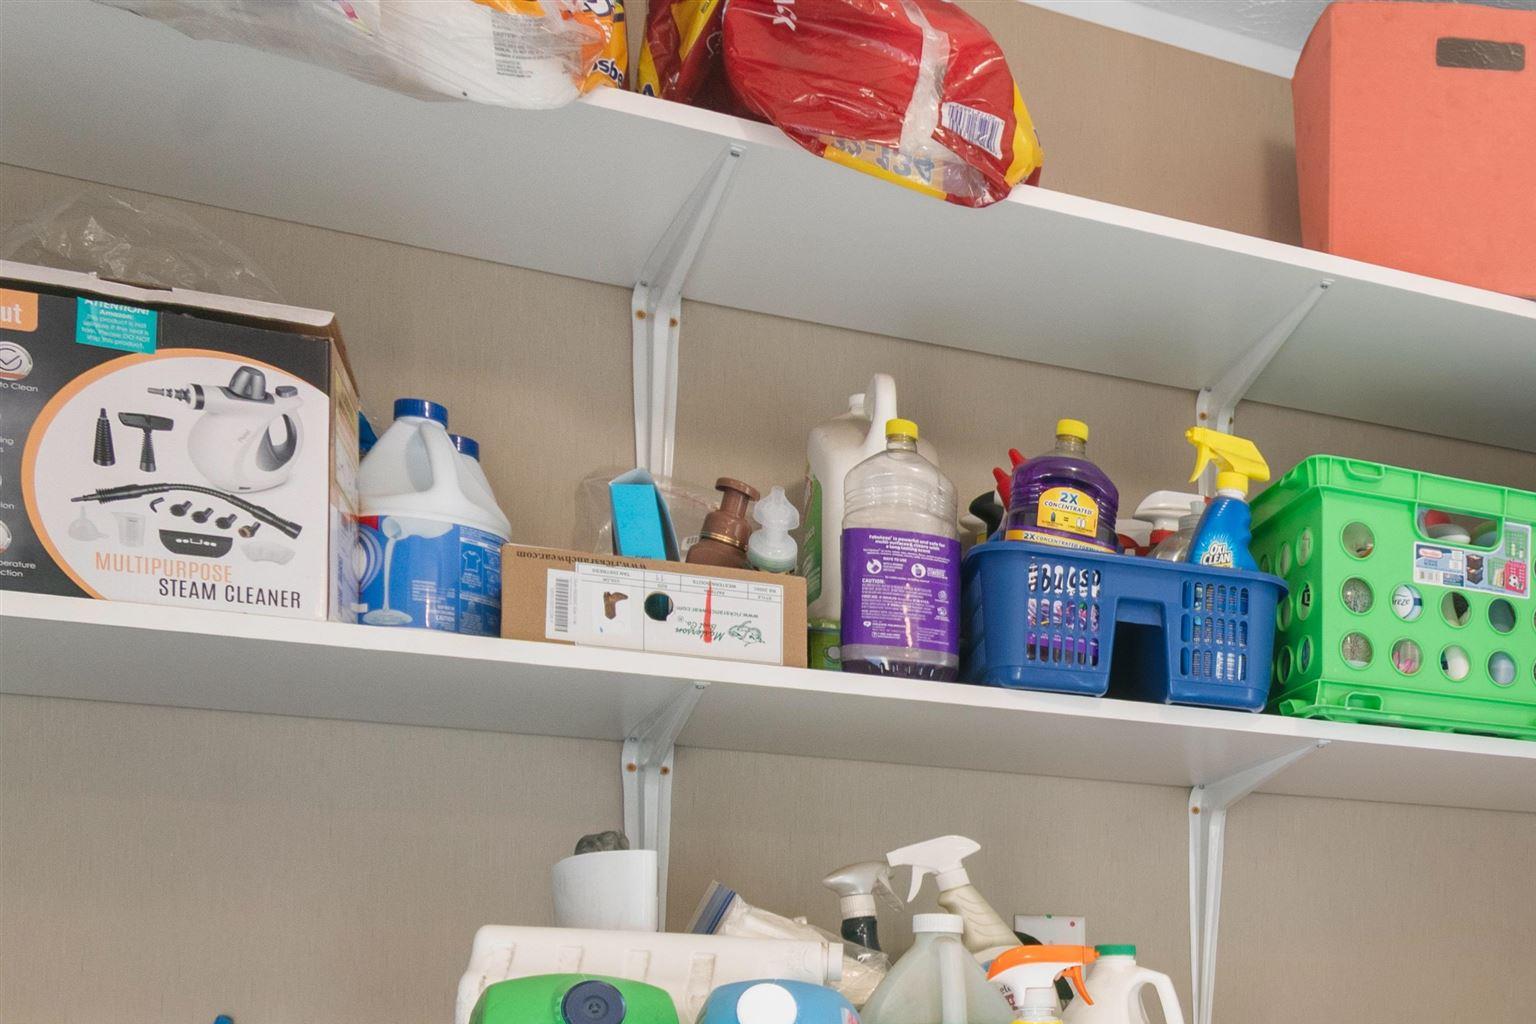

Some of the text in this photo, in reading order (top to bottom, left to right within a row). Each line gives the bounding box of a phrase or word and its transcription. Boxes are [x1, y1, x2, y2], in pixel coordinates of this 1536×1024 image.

[11, 382, 39, 393] Clean
[1060, 492, 1078, 505] 2X
[1024, 532, 1035, 540] 2X
[1210, 543, 1227, 555] OXI
[1202, 551, 1231, 566] CLEAN
[95, 551, 232, 583] MULTIPURPOSE
[159, 578, 301, 609] STEAM CLEANER
